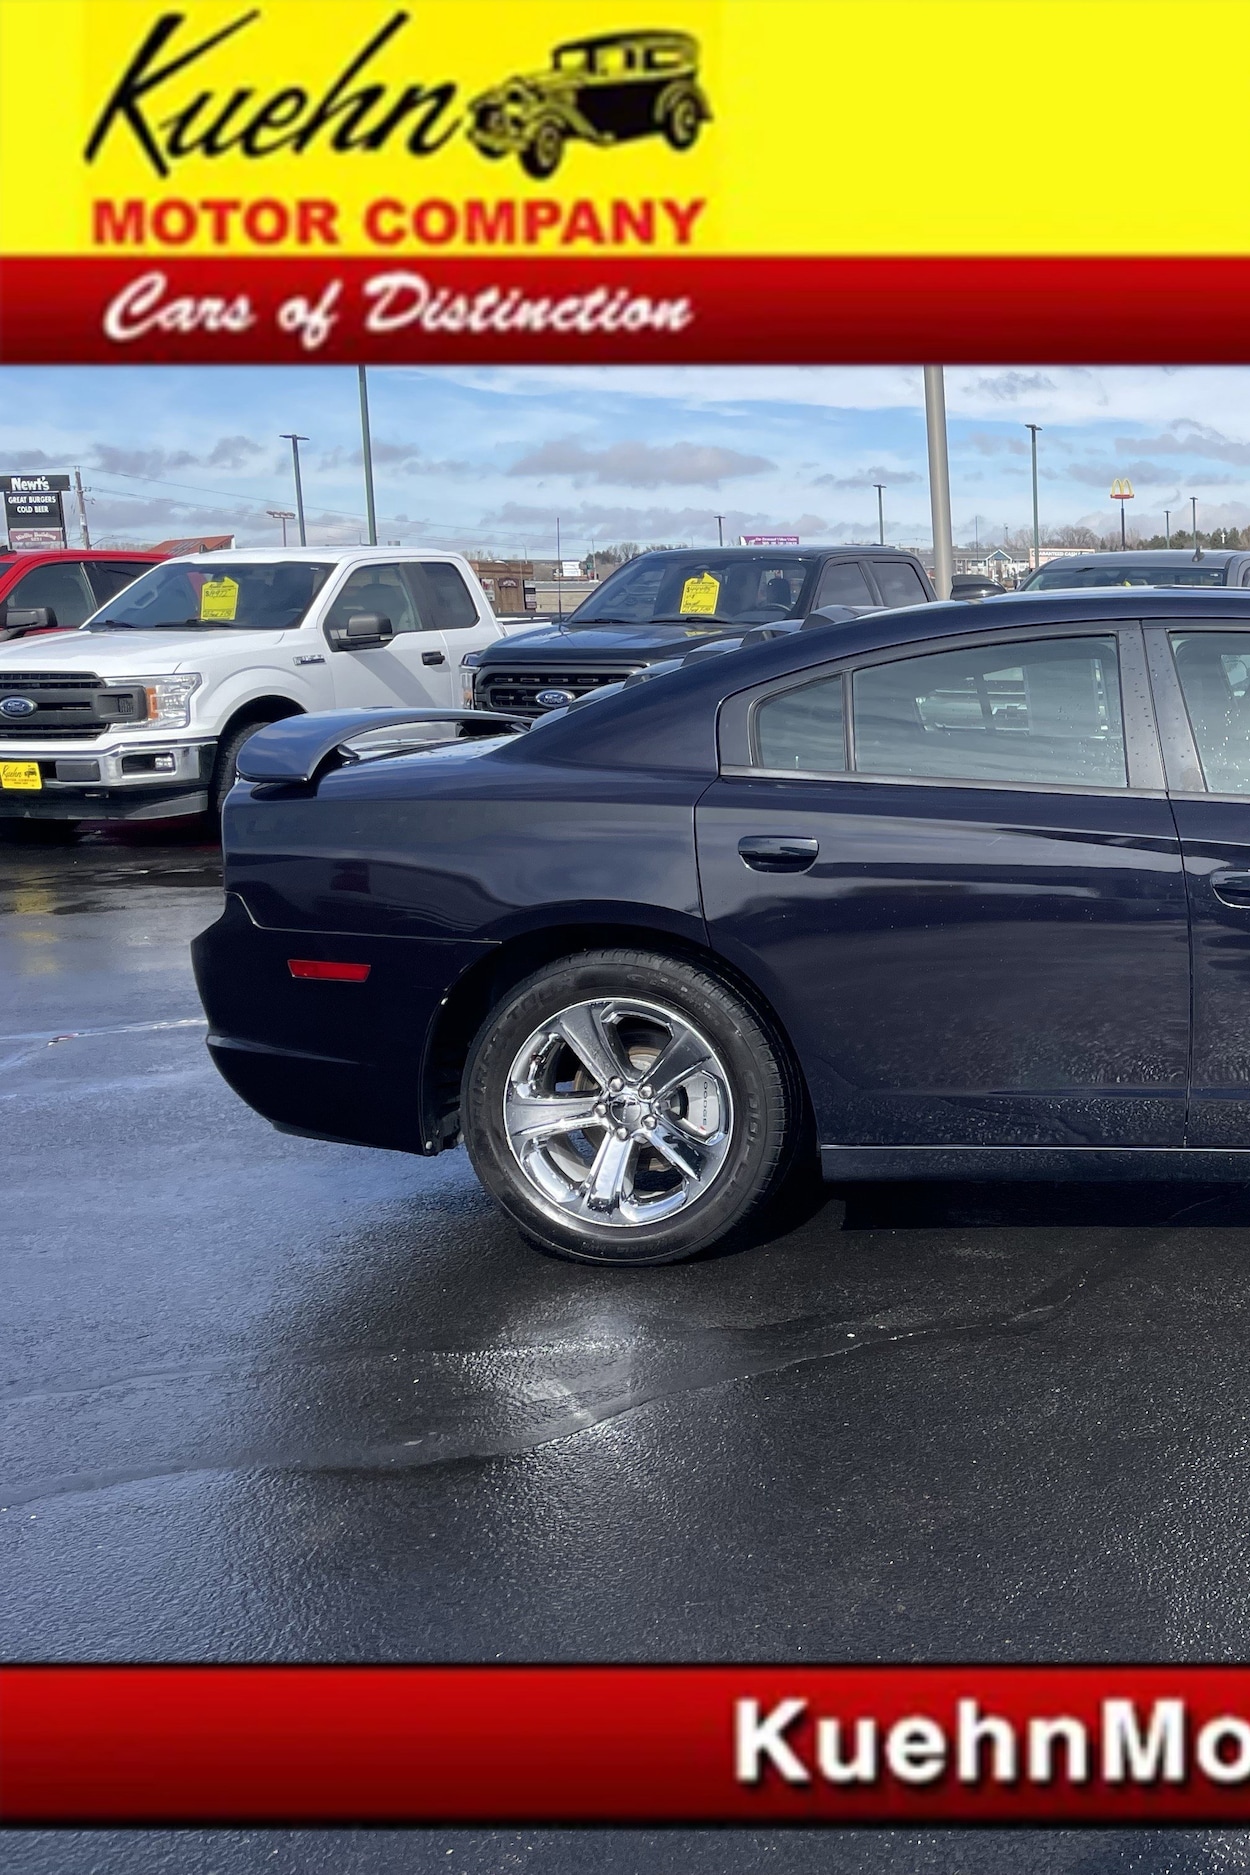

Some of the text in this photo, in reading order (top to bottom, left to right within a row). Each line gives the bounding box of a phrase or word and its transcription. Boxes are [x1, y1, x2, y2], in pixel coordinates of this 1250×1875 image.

[10, 475, 50, 491] Newt's
[8, 495, 56, 504] GREAT BURGERS
[34, 505, 49, 513] BEER
